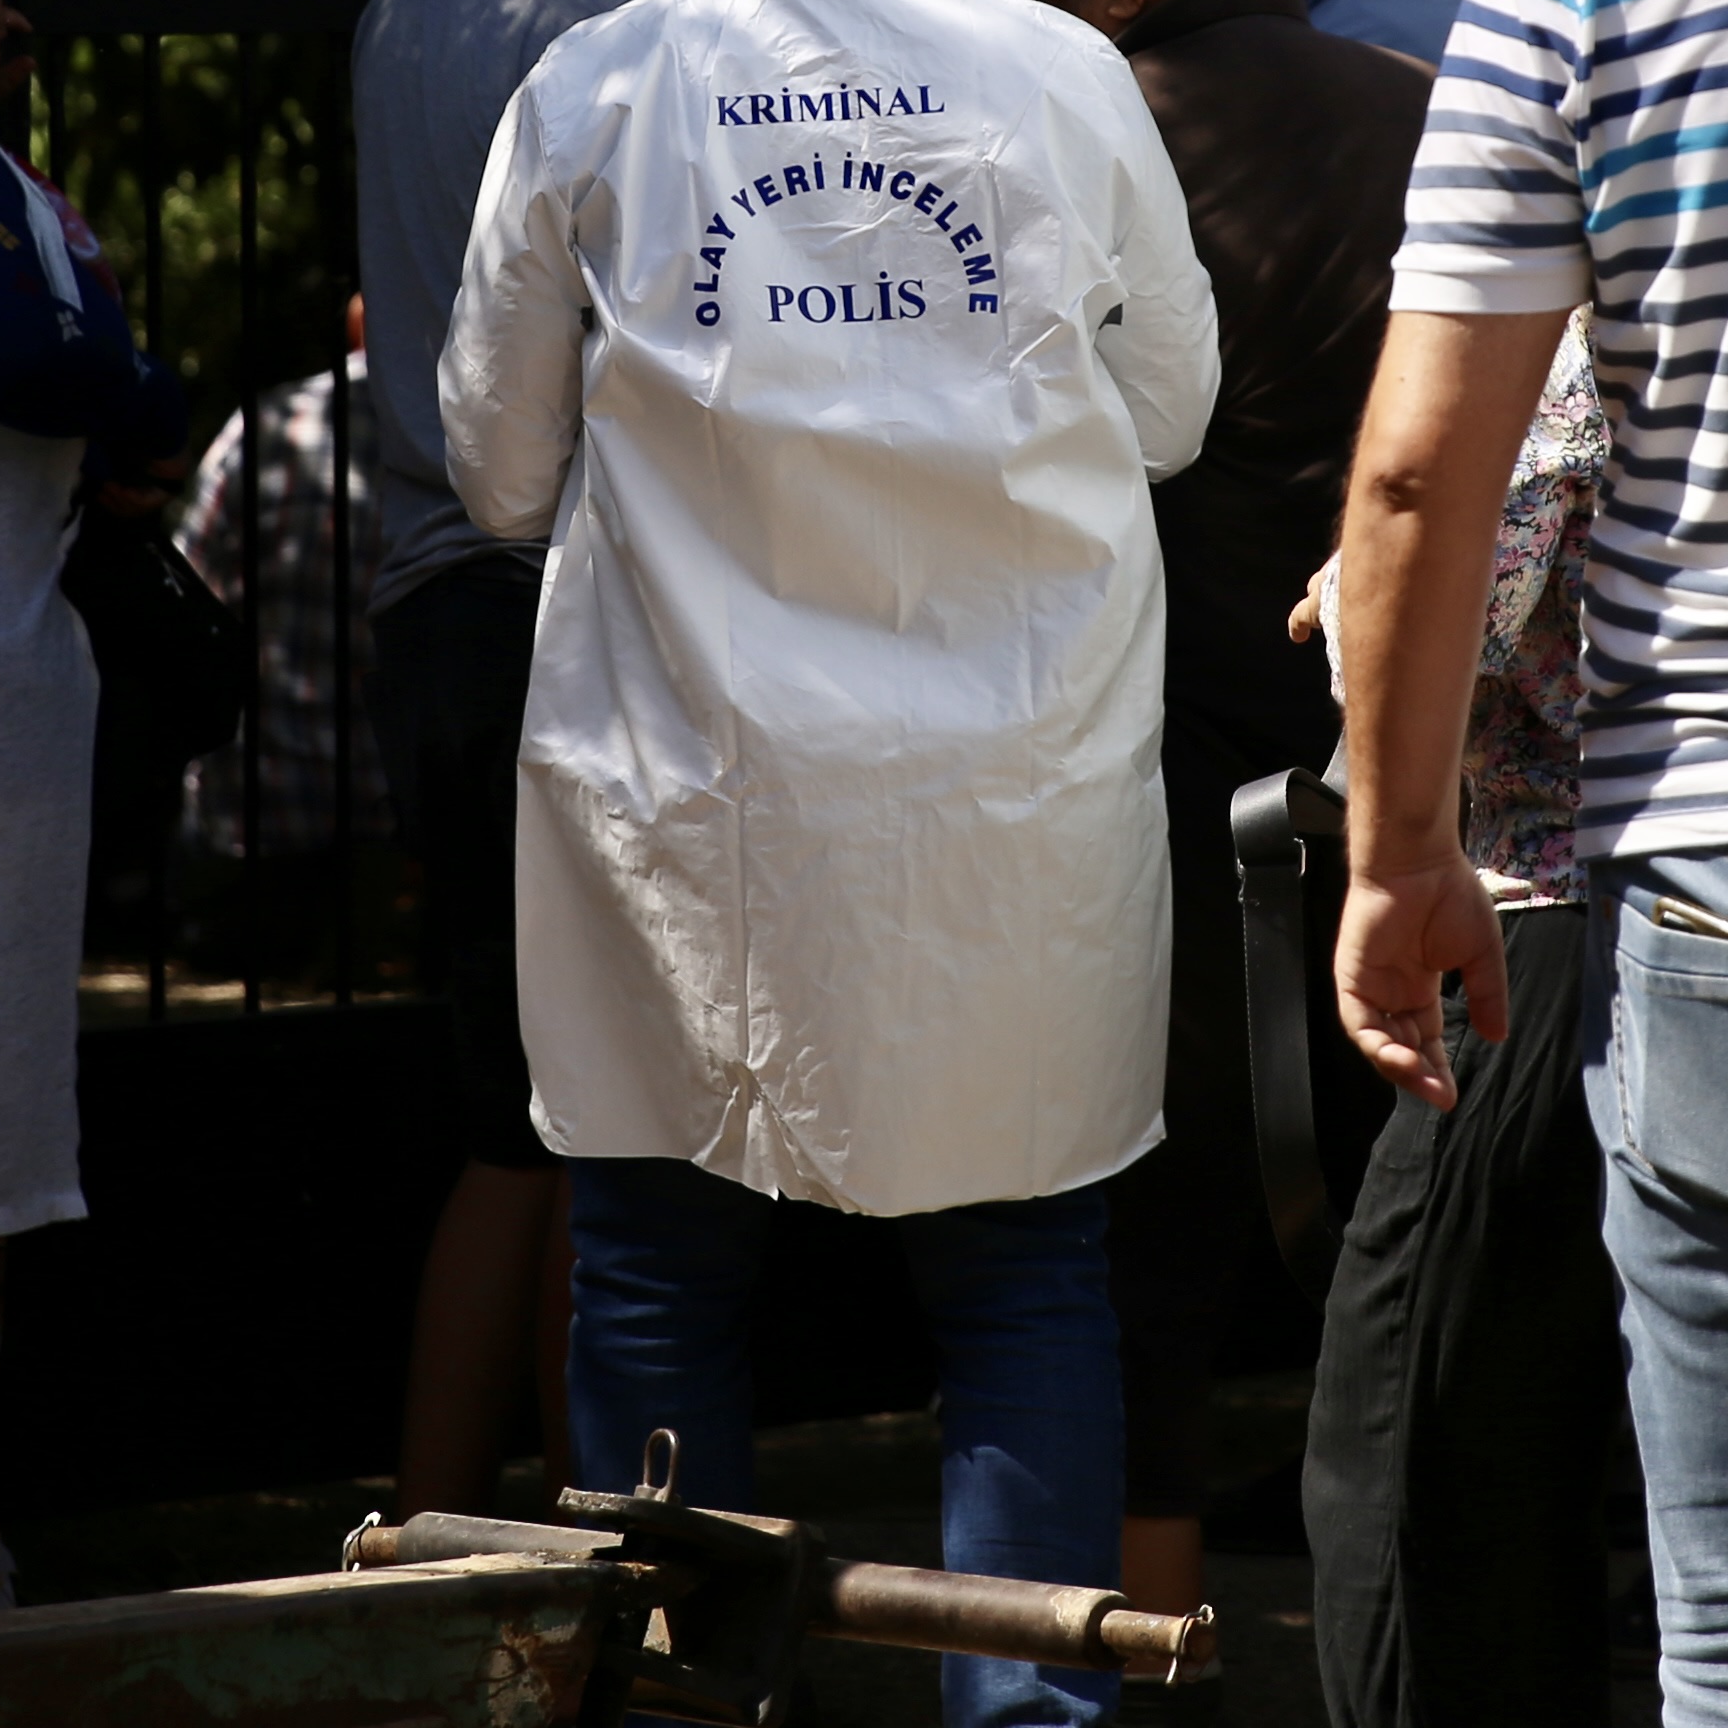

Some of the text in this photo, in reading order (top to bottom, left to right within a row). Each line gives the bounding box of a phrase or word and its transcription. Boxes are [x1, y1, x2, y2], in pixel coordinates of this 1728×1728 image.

[716, 82, 946, 127] KRİMİNAL
[693, 151, 999, 327] OLAY YERİ İNCELEME
[766, 270, 927, 323] POLİS
